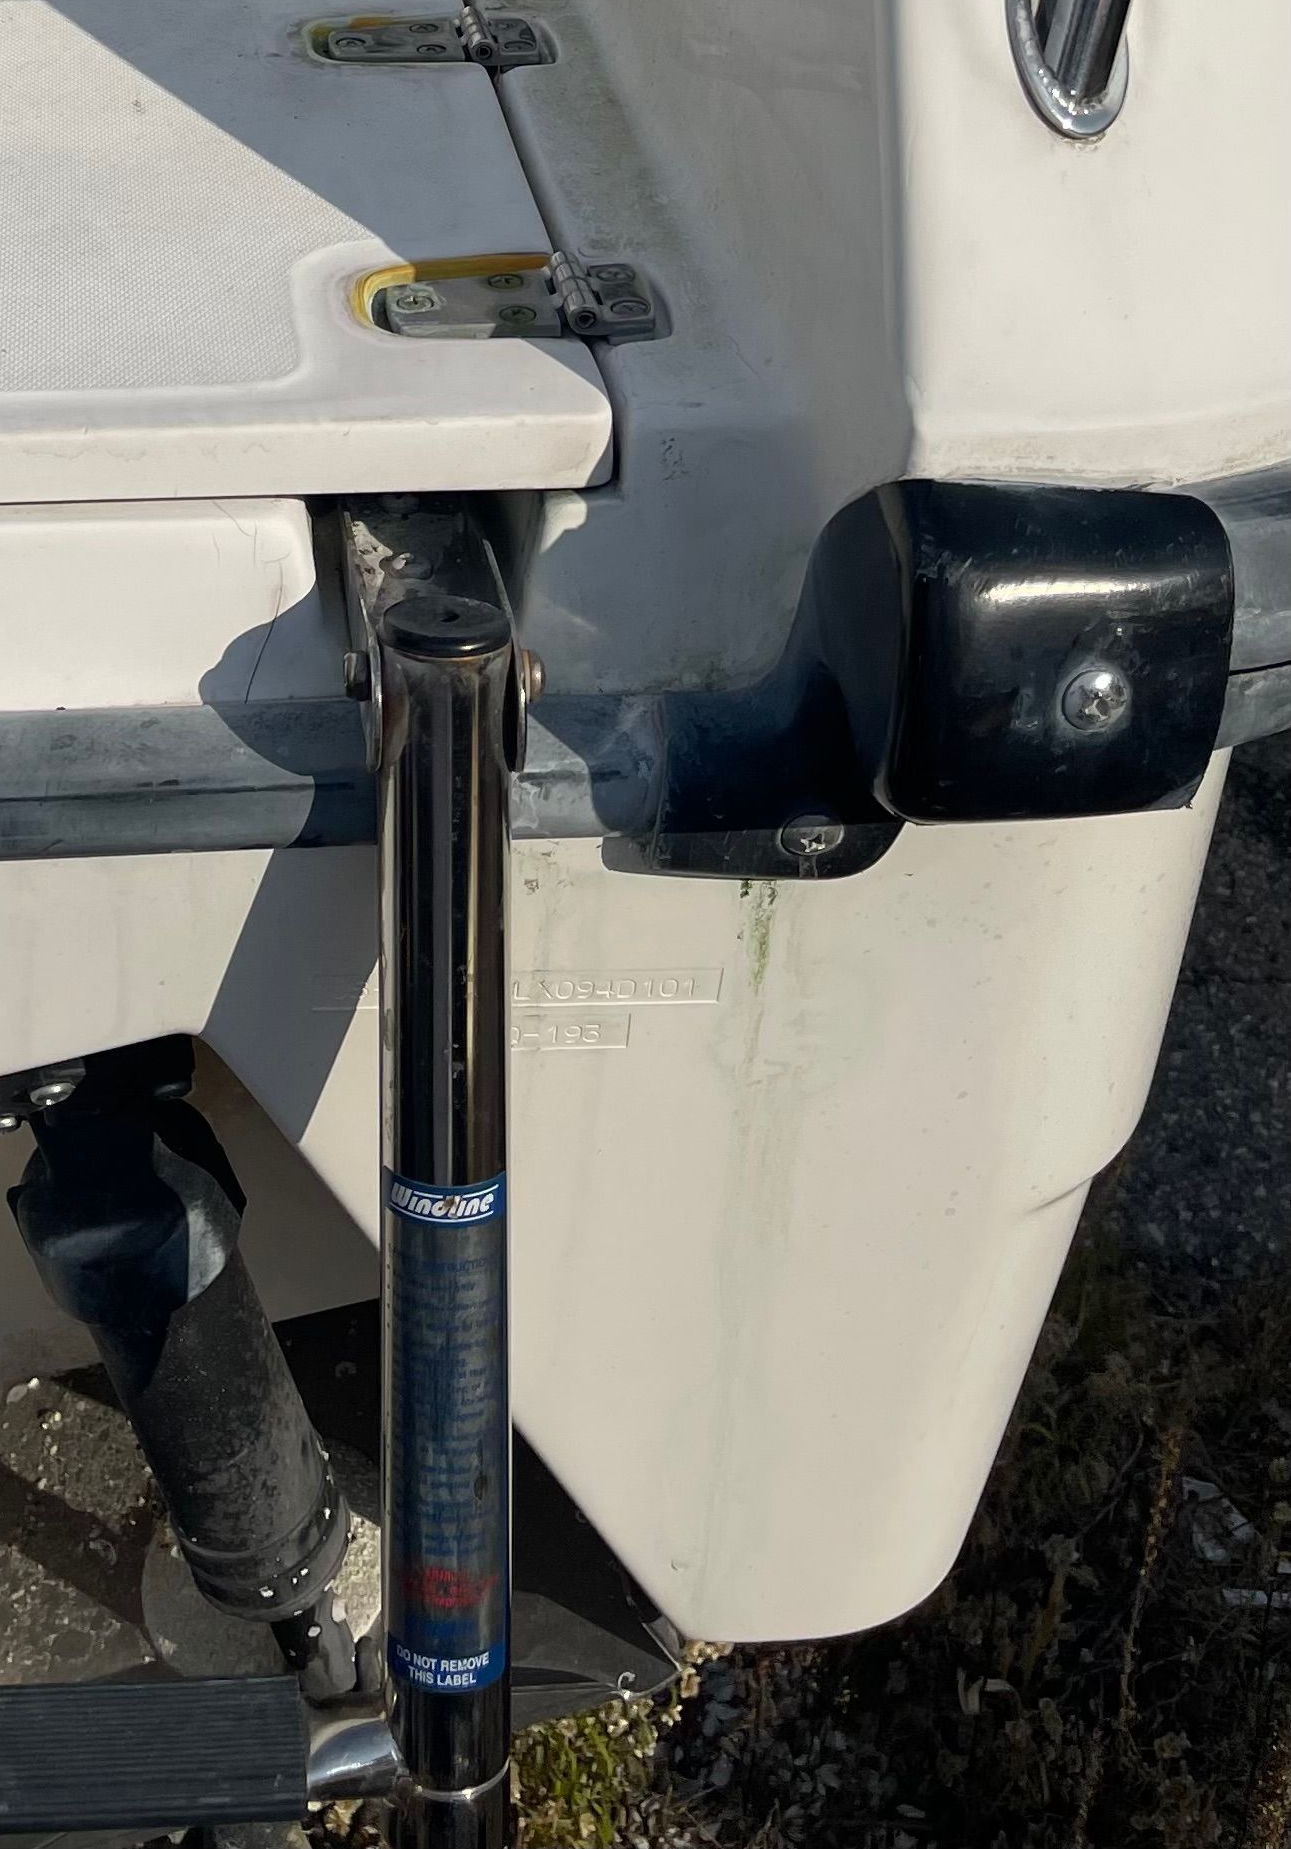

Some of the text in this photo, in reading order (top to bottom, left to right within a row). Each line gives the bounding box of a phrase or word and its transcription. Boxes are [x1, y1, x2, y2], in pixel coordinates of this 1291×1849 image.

[396, 1644, 490, 1672] DO NOT REMOVE
[408, 1666, 477, 1686] THIS LABEL
